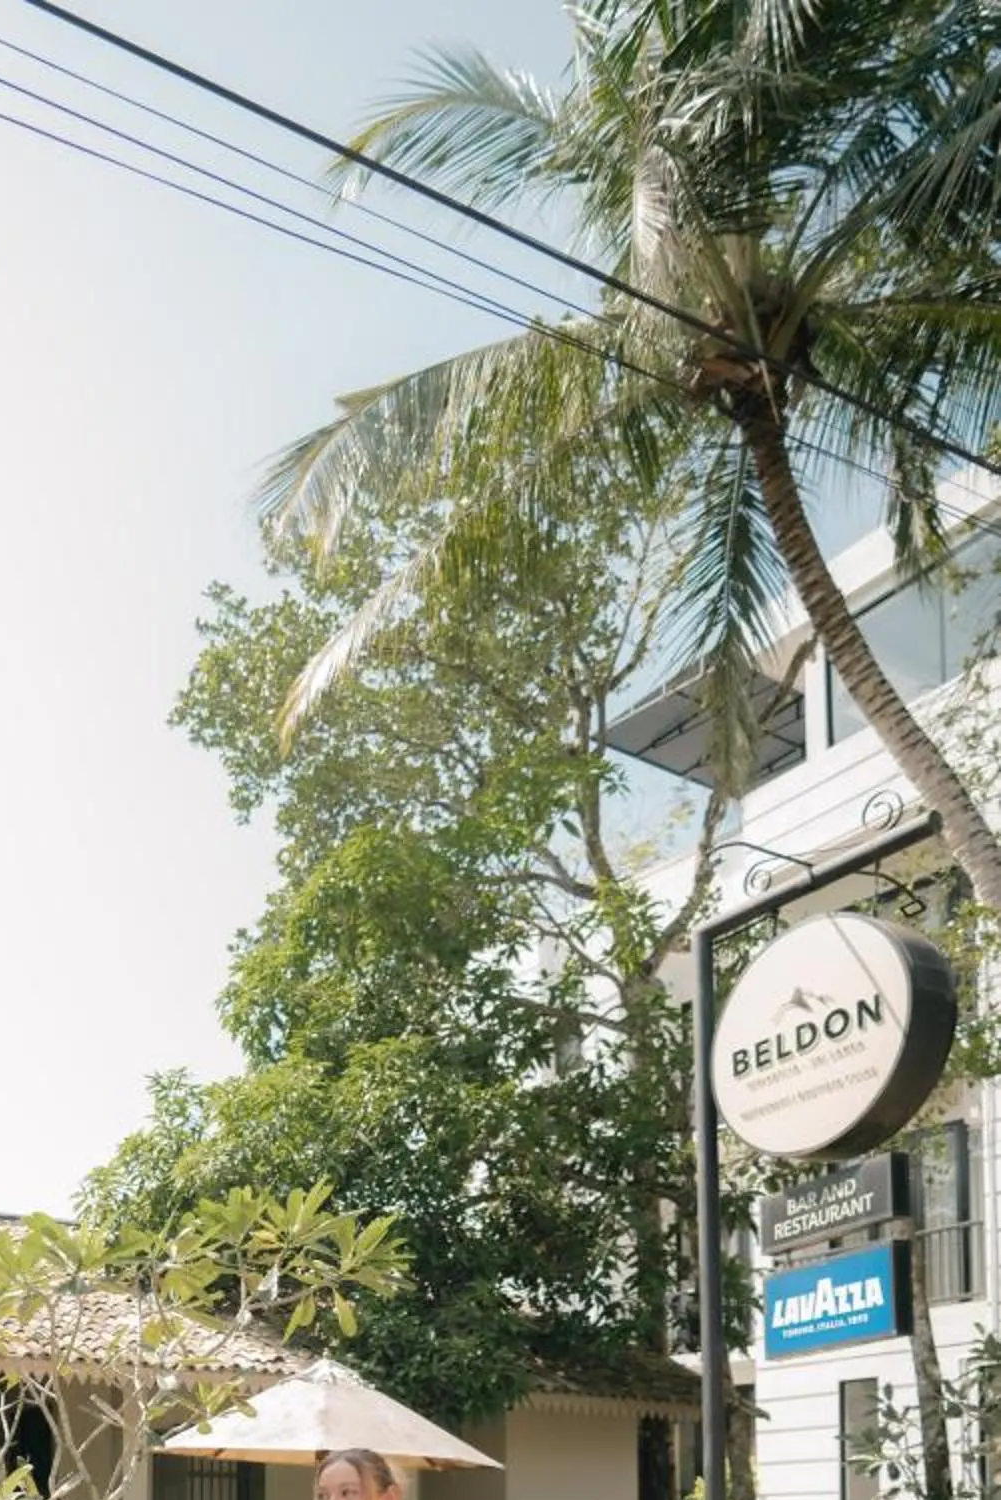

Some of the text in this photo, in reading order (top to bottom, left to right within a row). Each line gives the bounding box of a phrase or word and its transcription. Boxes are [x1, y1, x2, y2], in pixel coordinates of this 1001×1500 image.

[732, 993, 883, 1077] BELDON
[774, 1192, 875, 1240] RESTAURANT
[787, 1179, 856, 1216] BAR AND
[772, 1277, 884, 1329] LAVAZZA
